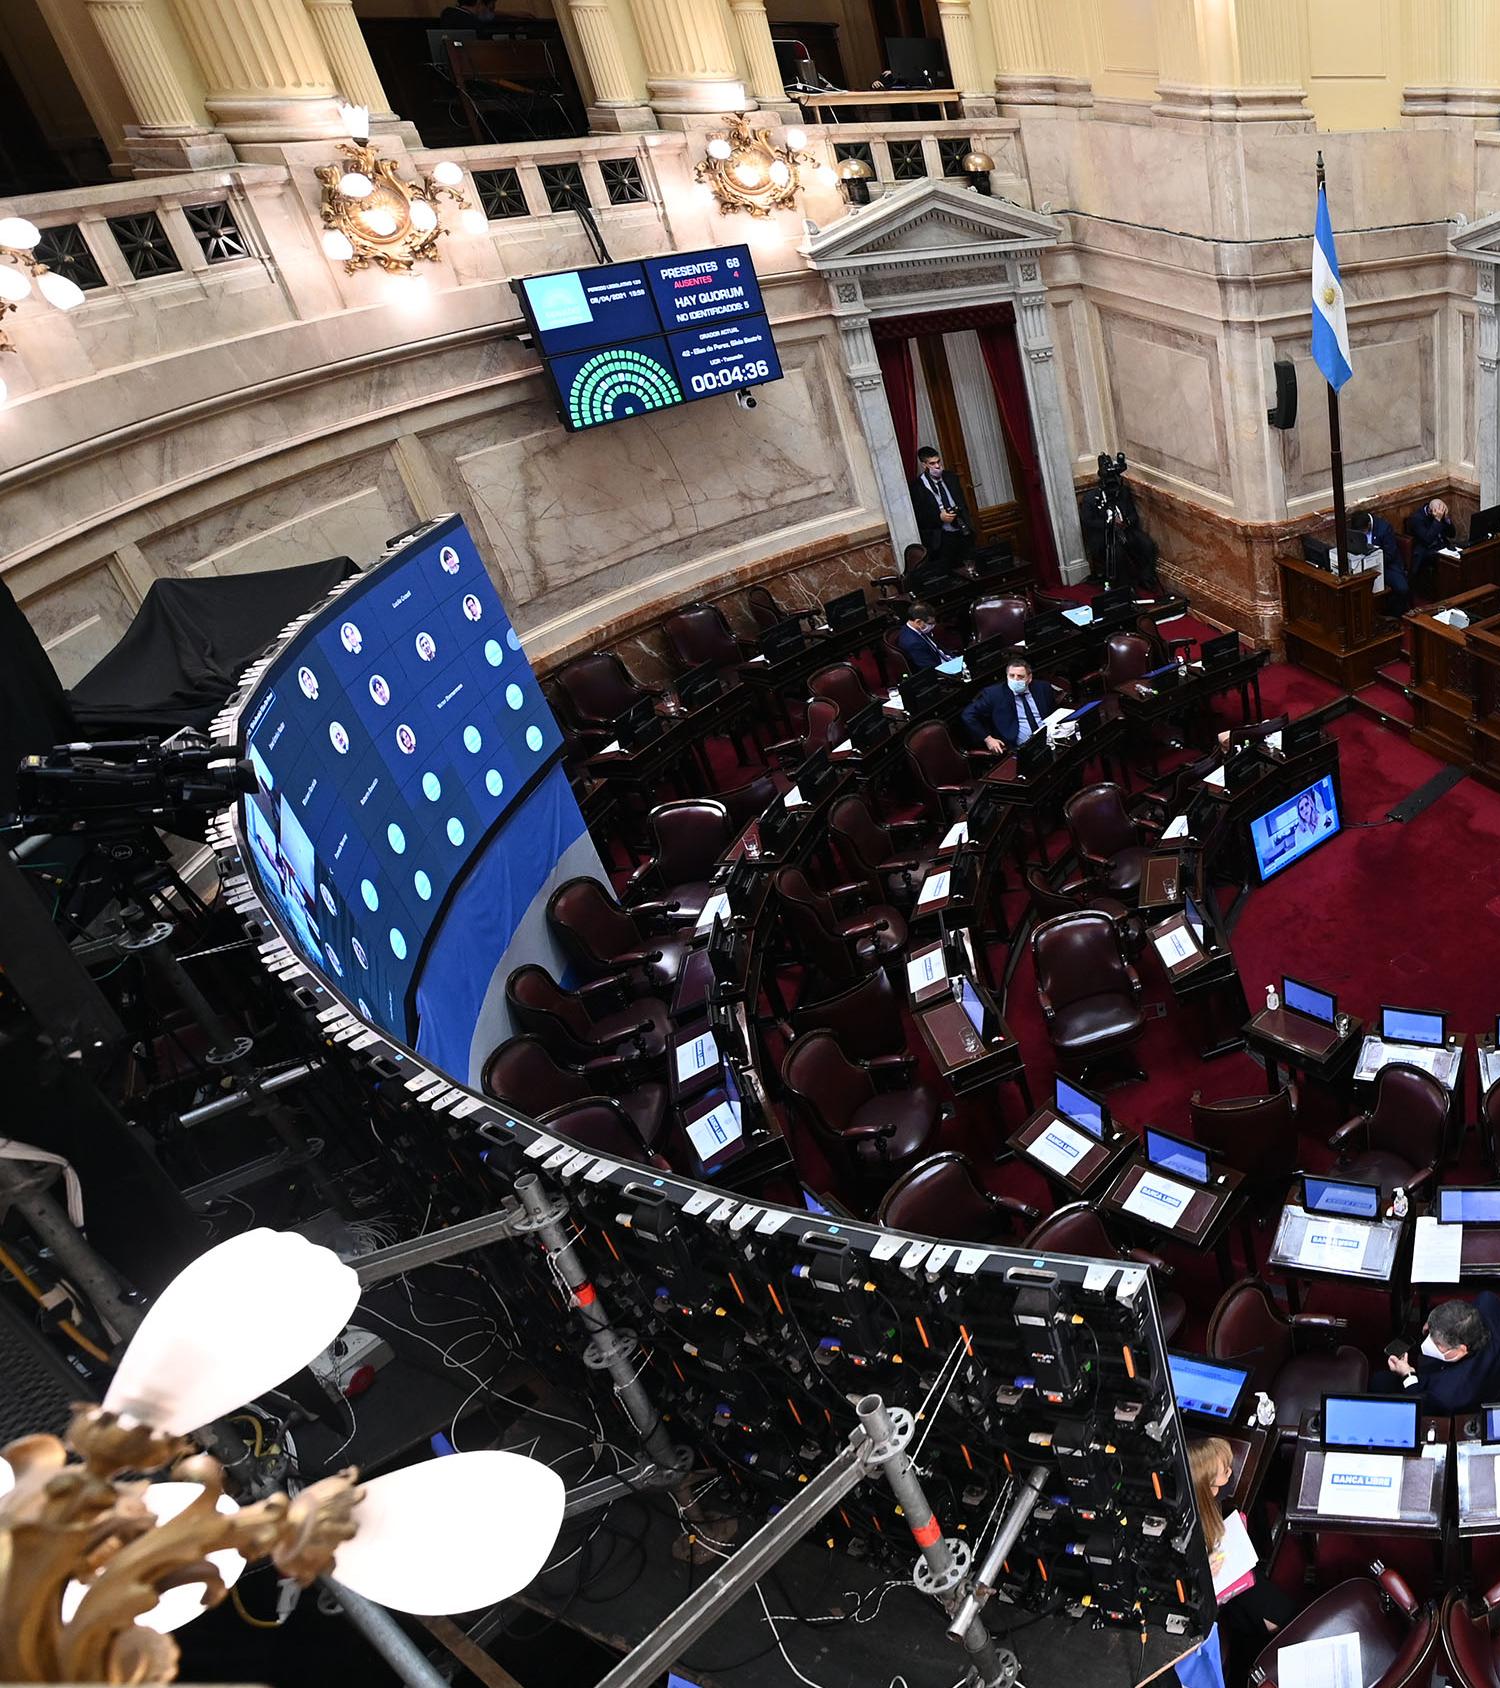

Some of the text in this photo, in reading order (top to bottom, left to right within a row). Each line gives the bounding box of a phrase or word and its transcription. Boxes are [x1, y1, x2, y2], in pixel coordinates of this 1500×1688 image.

[660, 258, 740, 280] PRESENTES 68
[674, 270, 740, 288] AUSENTES 4
[674, 286, 744, 308] HAY QUORUM
[676, 313, 689, 322] NO
[699, 331, 720, 340] ORADOR
[691, 360, 769, 392] 00:04:36
[1046, 1133, 1066, 1148] BANCA
[1141, 1186, 1165, 1201] BANCA
[1333, 1474, 1391, 1487] BANCA LIBRE
